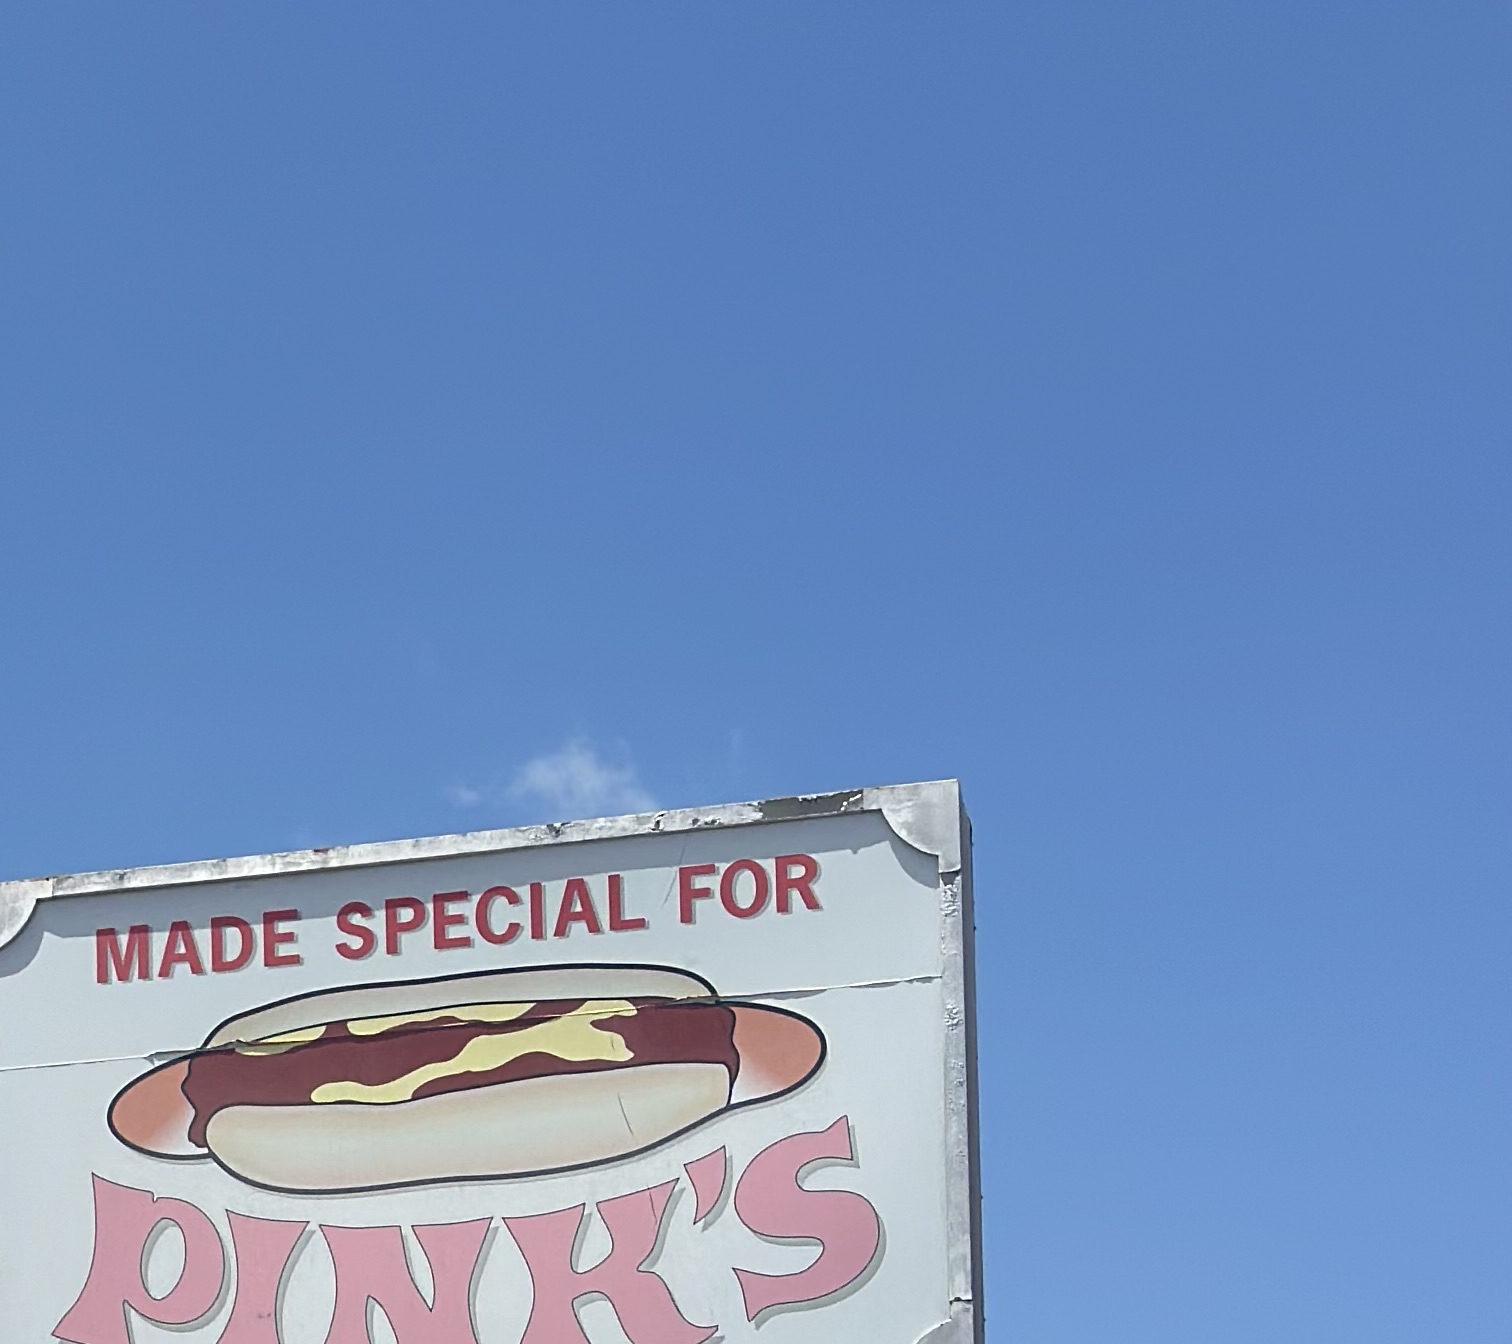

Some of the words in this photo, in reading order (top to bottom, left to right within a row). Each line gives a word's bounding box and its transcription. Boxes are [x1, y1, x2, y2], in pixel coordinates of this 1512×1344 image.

[94, 909, 302, 984] MADE
[335, 874, 646, 960] SPECIAL
[677, 852, 822, 924] FOR
